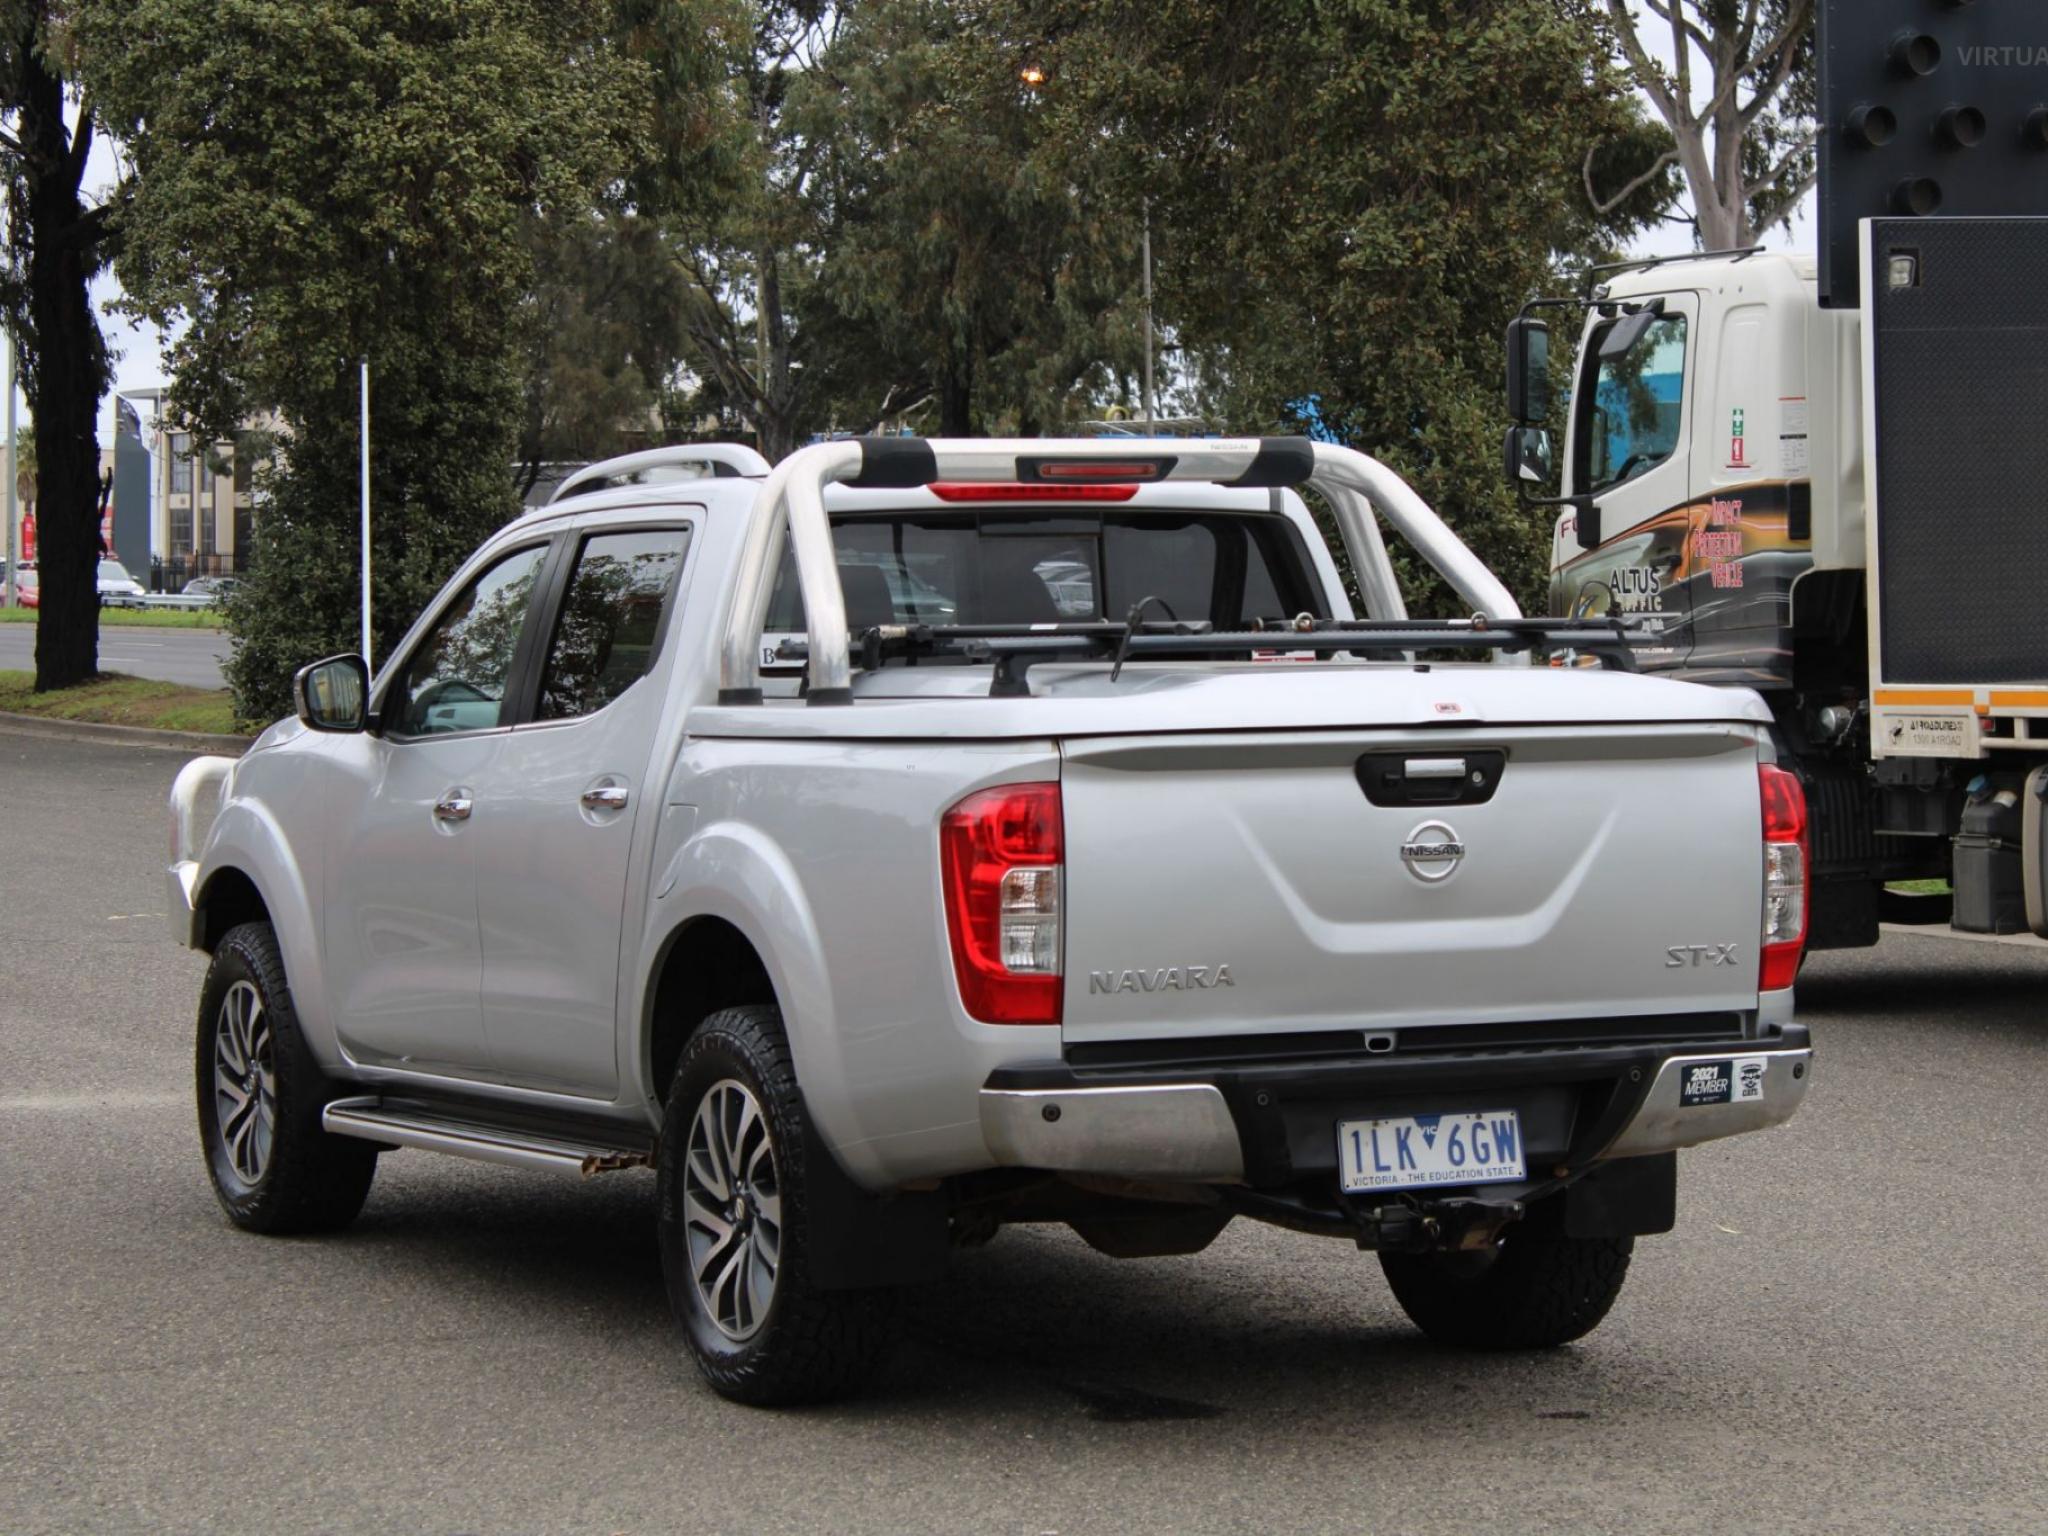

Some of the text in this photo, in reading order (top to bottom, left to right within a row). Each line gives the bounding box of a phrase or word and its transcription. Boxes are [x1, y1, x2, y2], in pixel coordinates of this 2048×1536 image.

[1610, 566, 1660, 595] ALTUS
[1408, 844, 1460, 857] NISSAN
[1665, 943, 1738, 968] ST-X
[1089, 964, 1235, 995] NAVARA
[1690, 1066, 1719, 1082] 2021
[1684, 1078, 1729, 1096] MEMBER
[1352, 1175, 1398, 1187] VICTORIA
[1408, 1173, 1426, 1183] THE
[1429, 1169, 1483, 1182] EDUCATION
[1487, 1165, 1515, 1177] STATE
